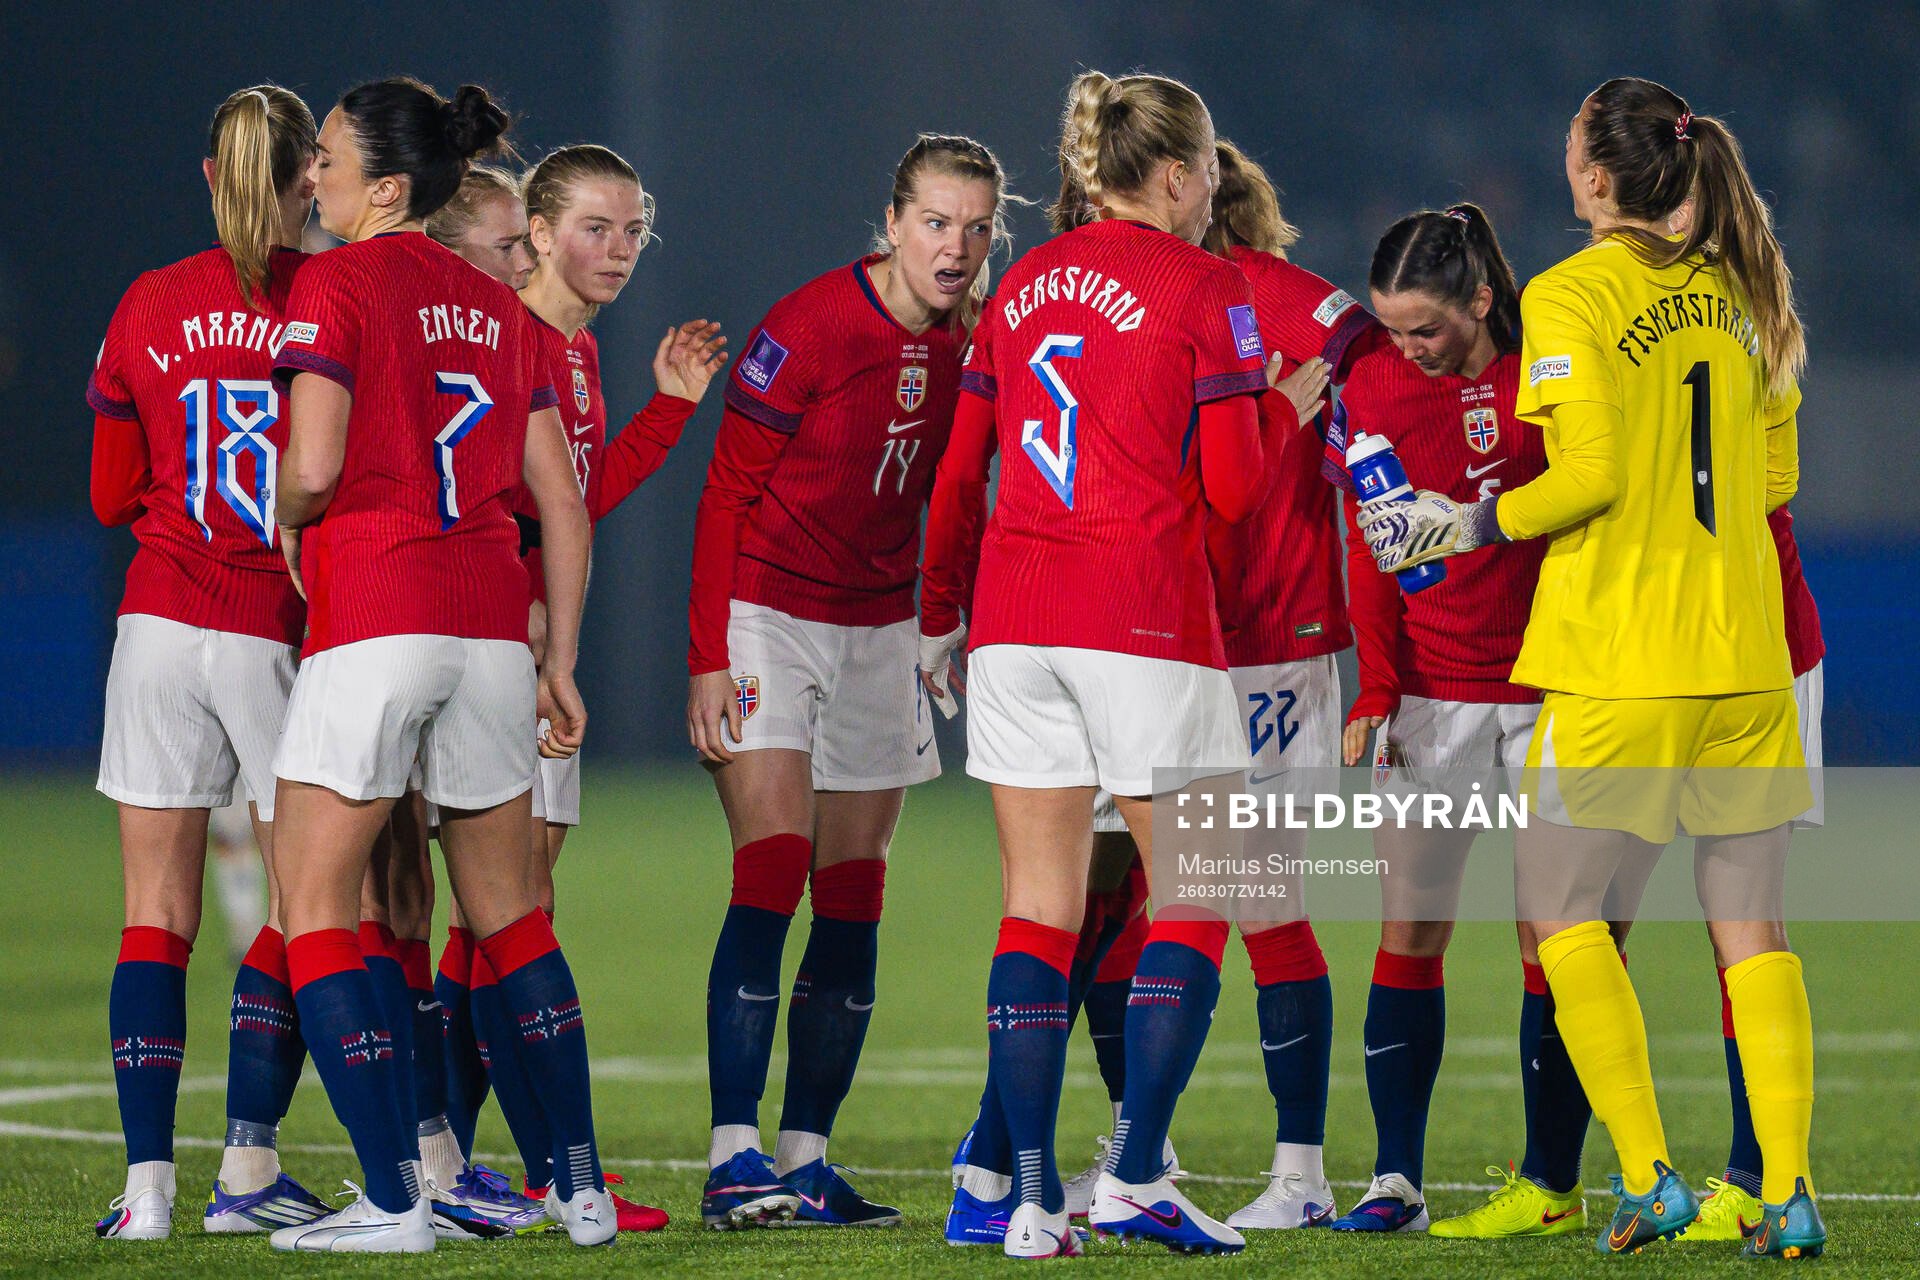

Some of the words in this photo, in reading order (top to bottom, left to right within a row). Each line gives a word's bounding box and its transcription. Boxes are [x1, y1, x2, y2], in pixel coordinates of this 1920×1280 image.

[182, 312, 283, 359] MAANU
[418, 304, 500, 351] ENGEN
[1021, 334, 1085, 512] 5
[1461, 387, 1475, 396] NOR
[178, 378, 279, 550] 18
[434, 371, 495, 532] 7
[872, 439, 921, 497] 14
[1682, 361, 1717, 538] 1
[1247, 689, 1299, 757] 22
